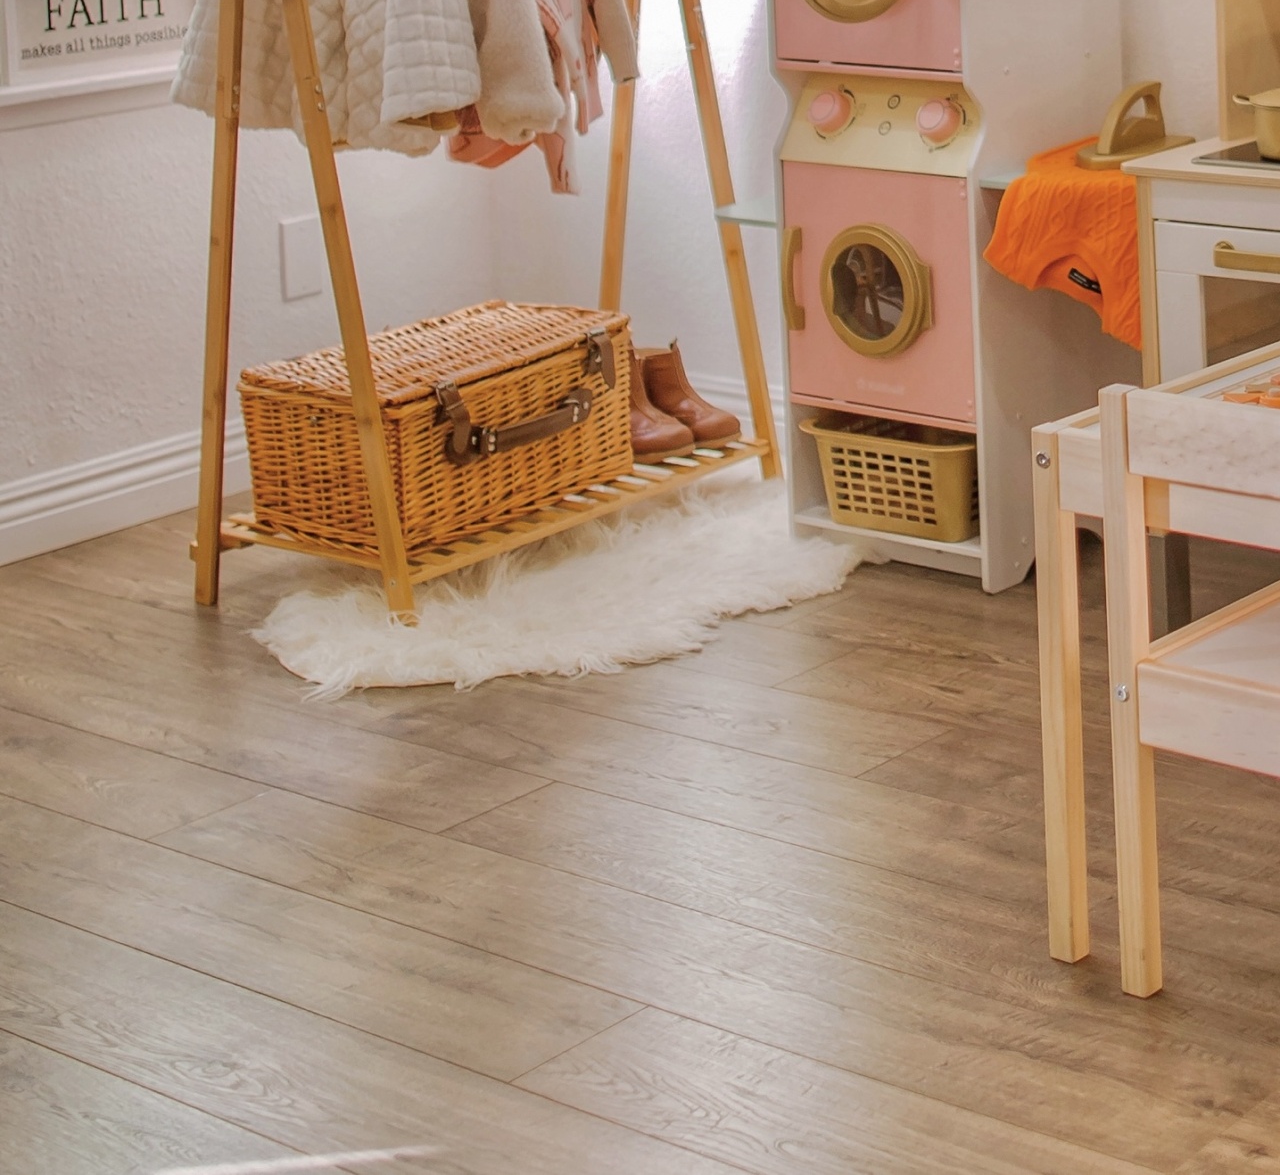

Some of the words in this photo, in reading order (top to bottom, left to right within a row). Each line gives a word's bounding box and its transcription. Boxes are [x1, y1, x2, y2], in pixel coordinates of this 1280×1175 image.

[21, 42, 62, 60] makes
[65, 38, 86, 53] all
[89, 32, 132, 51] things
[135, 26, 189, 47] possible
